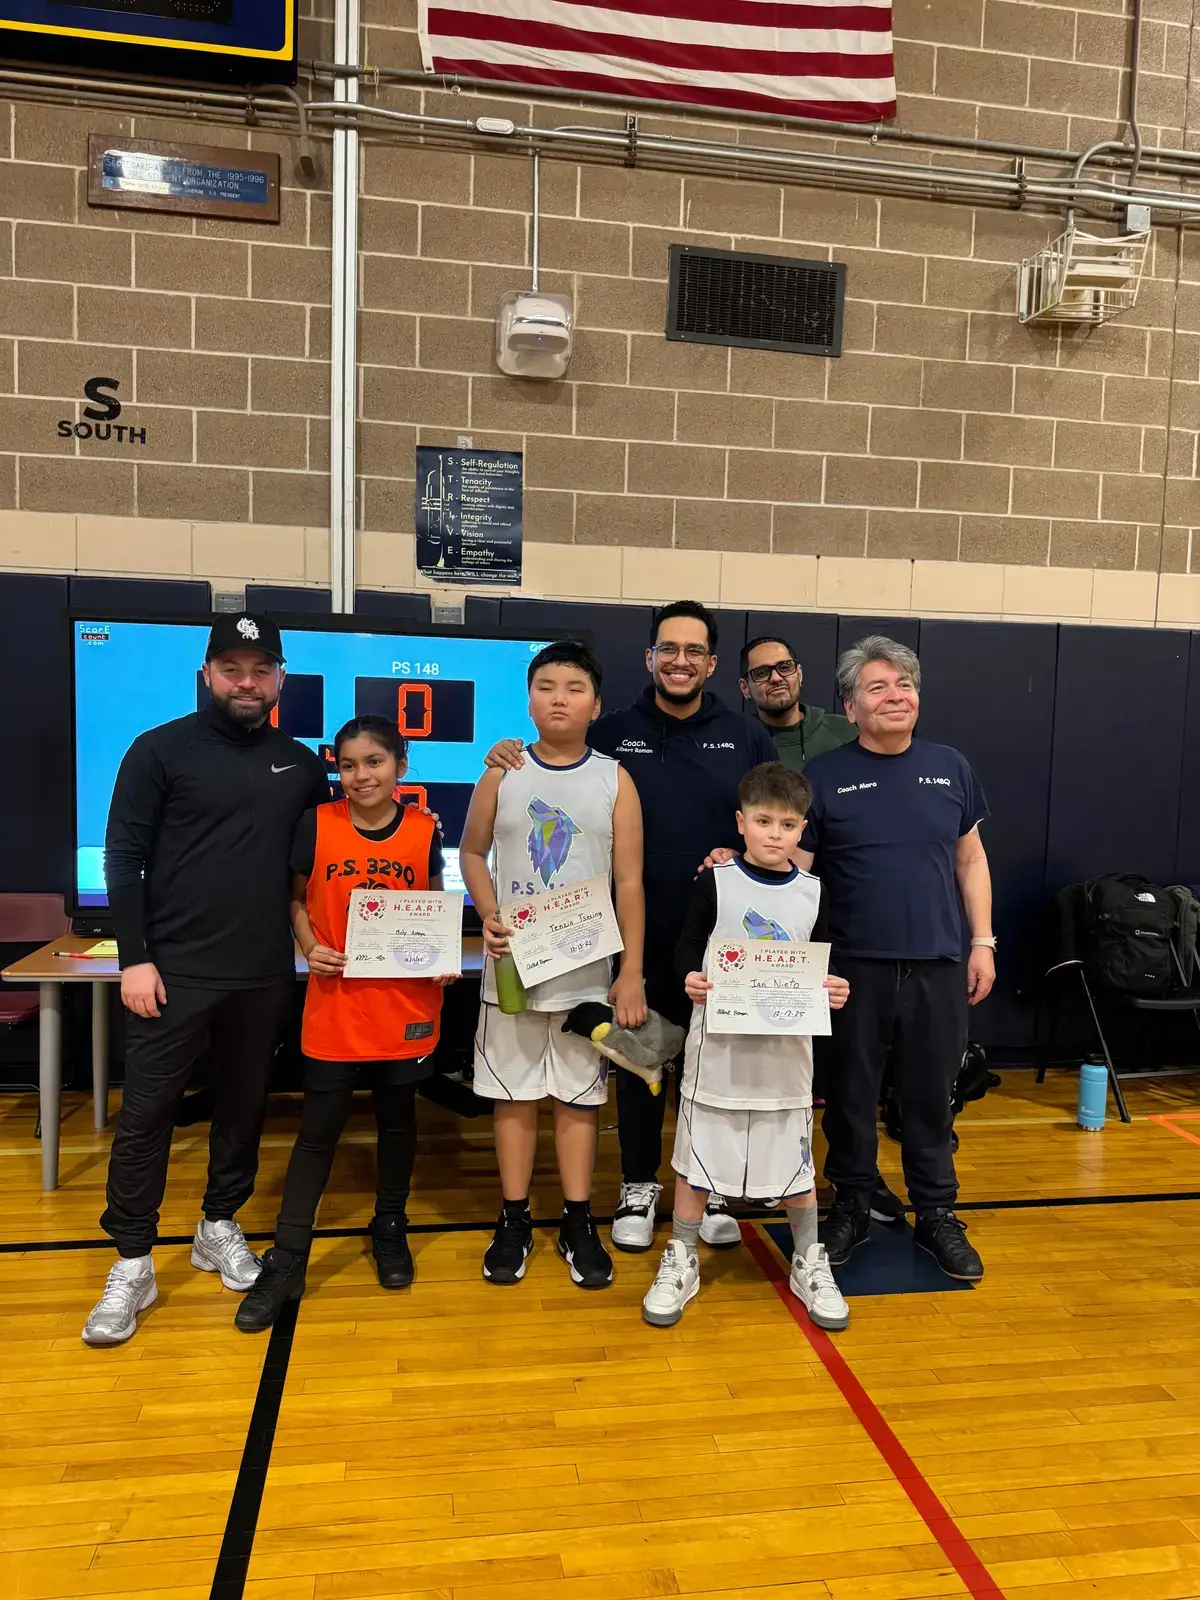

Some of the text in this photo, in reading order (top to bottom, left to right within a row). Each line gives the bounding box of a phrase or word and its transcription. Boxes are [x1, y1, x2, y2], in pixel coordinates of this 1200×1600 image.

[182, 167, 203, 178] FROM
[207, 170, 221, 179] THE
[227, 172, 265, 184] 1995-1996
[186, 176, 240, 190] ORGANIZATION
[83, 376, 121, 421] S
[57, 420, 147, 445] SOUTH
[447, 457, 454, 466] S
[460, 458, 518, 469] Self-Regulation
[447, 475, 454, 483] T
[460, 476, 492, 487] Tenacity
[447, 493, 454, 501] R
[460, 493, 490, 504] Respect
[460, 511, 492, 522] Integrity
[447, 528, 454, 536] V
[460, 529, 484, 538] Vision
[447, 546, 454, 555] E
[460, 547, 495, 558] Empathy
[391, 661, 440, 676] PS 148
[398, 683, 432, 737] 0
[621, 739, 647, 747] Coach
[702, 742, 735, 750] P.S.148Q
[837, 781, 877, 794] Coach Mora
[918, 776, 951, 787] P.S.148Q
[326, 859, 360, 882] P.S.
[551, 892, 572, 902] PLAYED
[573, 886, 588, 894] WITH
[543, 890, 593, 911] H.E.A.R.T.
[393, 904, 446, 913] H.E.A.R.T.
[549, 920, 574, 933] Tenzin
[754, 954, 810, 964] H.E.A.R.T.
[750, 979, 766, 989] Ian
[773, 977, 800, 989] Nieto
